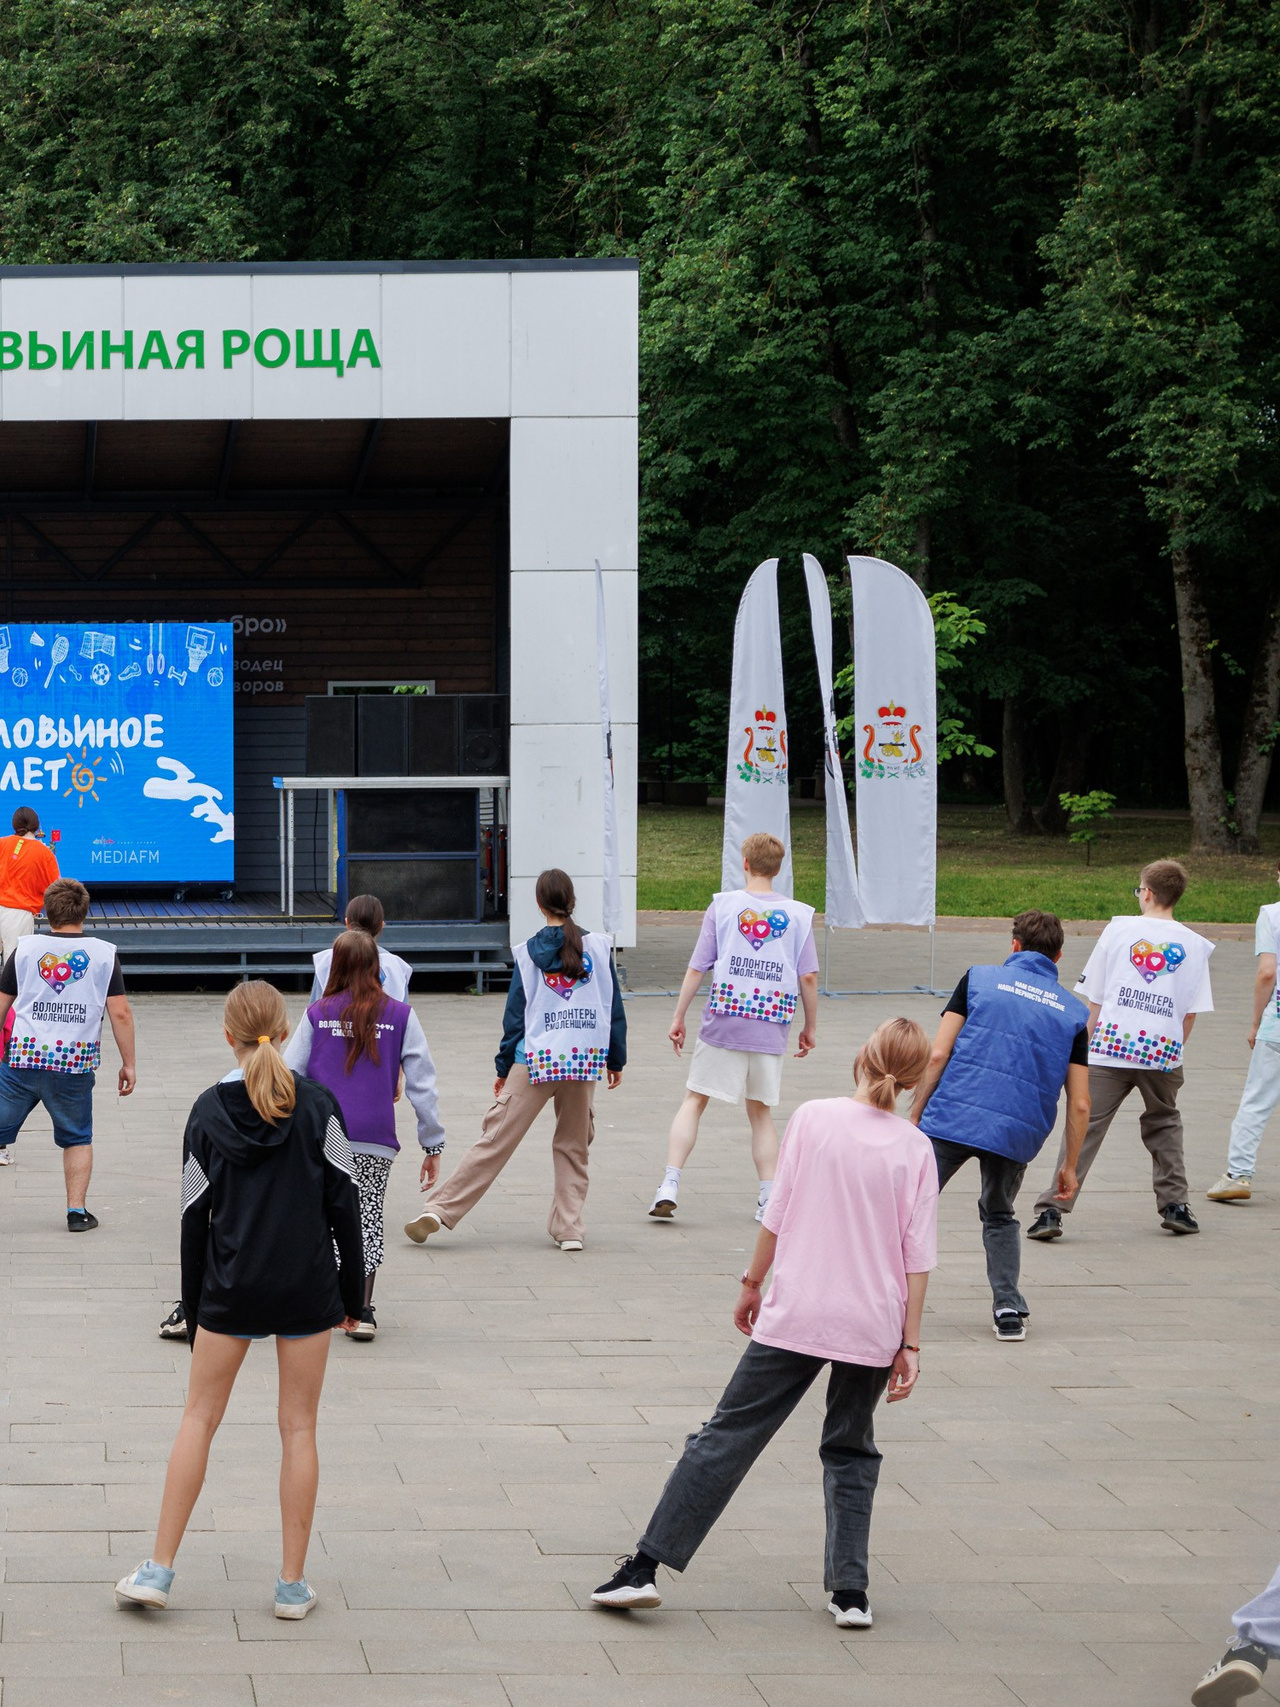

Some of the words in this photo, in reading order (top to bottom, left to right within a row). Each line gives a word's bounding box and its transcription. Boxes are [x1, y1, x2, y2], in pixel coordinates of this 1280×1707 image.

[224, 327, 382, 378] РОЩА
[229, 614, 287, 637] бро»
[90, 850, 160, 864] MEDIAFM
[730, 955, 784, 973] ВОЛОНТЕРЫ
[728, 966, 782, 982] СМОЛЕНЩИНЫ
[32, 1001, 87, 1015] ВОЛОНТЕРЫ
[544, 1008, 597, 1024] ВОЛОНТЕРЫ
[31, 1012, 86, 1024] СМОЛЕНЩИНЫ
[545, 1020, 597, 1032] СМОЛЕНЩИНЫ
